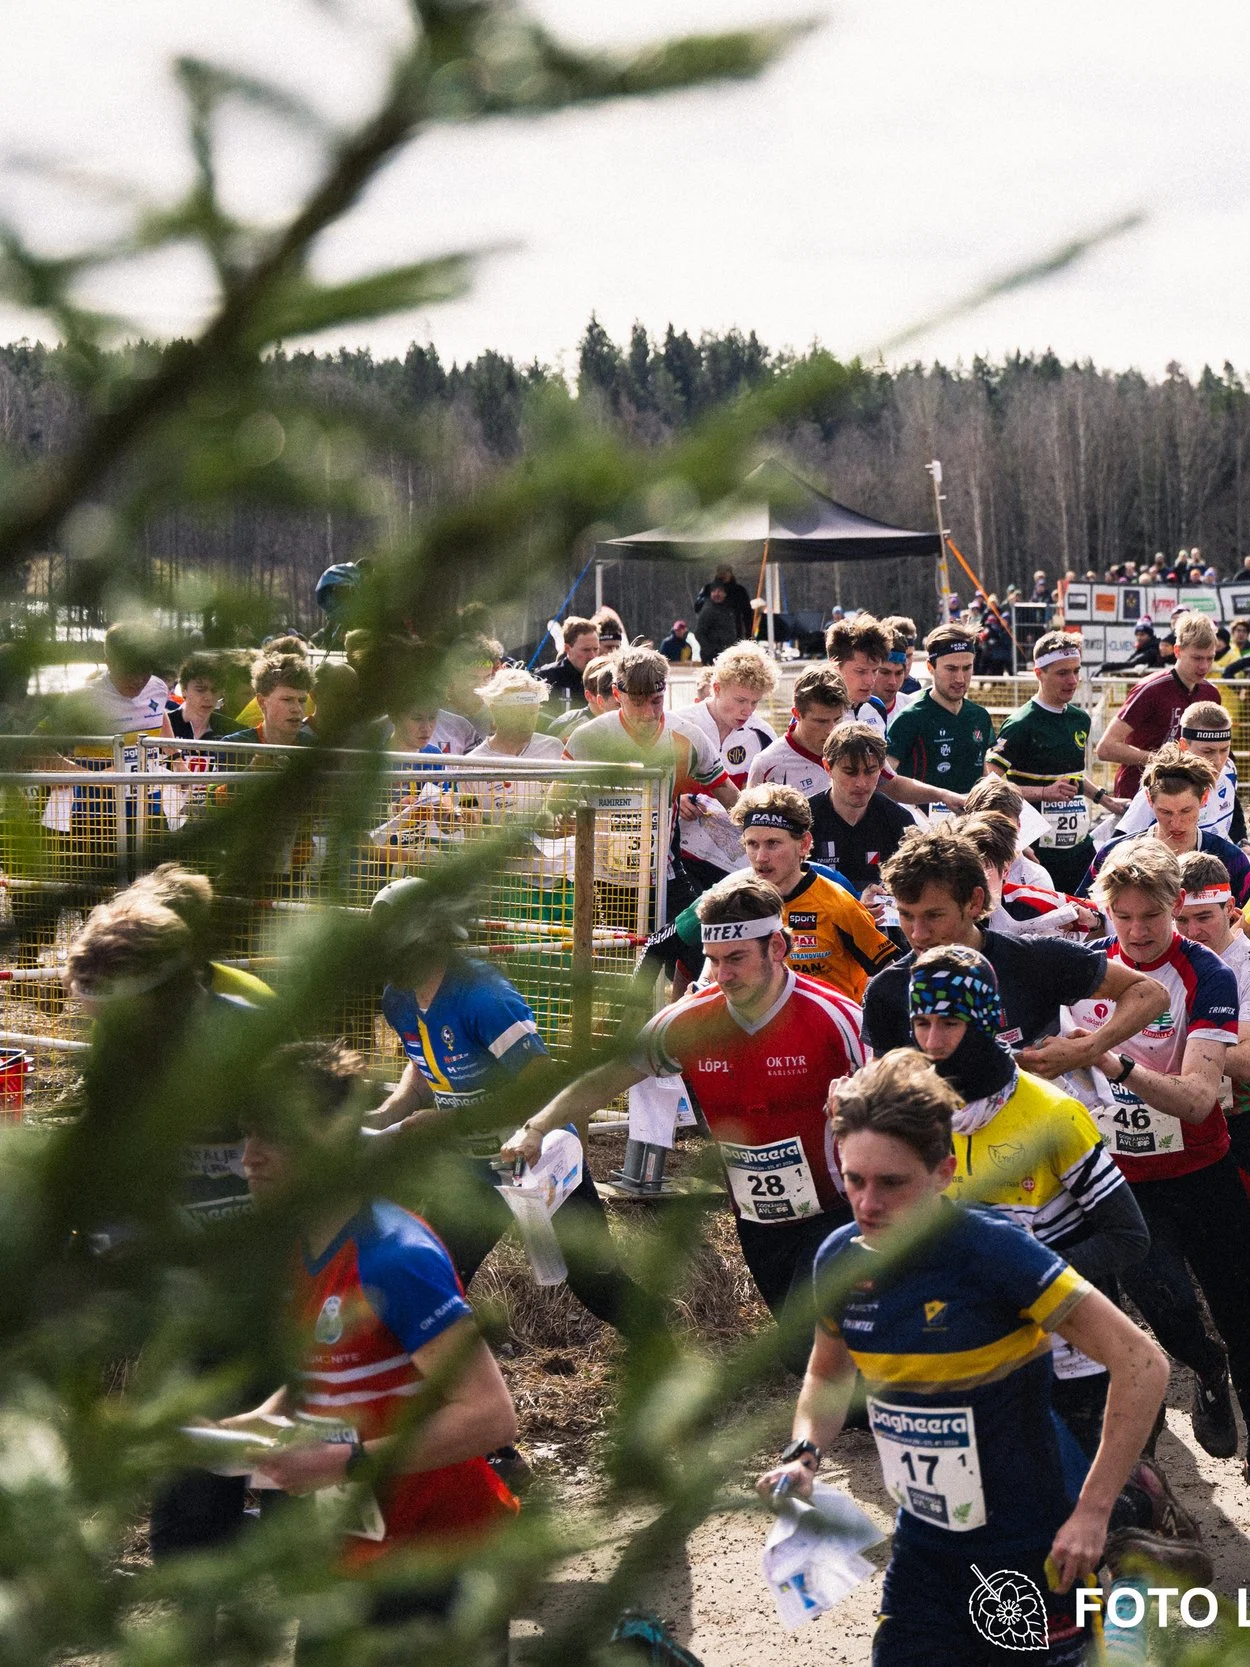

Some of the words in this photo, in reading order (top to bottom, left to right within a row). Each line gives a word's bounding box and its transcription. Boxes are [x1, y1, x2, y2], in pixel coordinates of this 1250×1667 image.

[799, 778, 813, 787] TB
[597, 798, 632, 807] RAMIRENT
[751, 813, 788, 823] PAN-
[1056, 816, 1078, 830] 20
[789, 914, 816, 924] sport
[703, 924, 744, 941] MTEX
[1208, 1006, 1236, 1016] TRIMTEX
[766, 1056, 783, 1068] OK
[785, 1055, 806, 1067] TYR
[767, 1067, 808, 1077] KARLSTAD
[1113, 1107, 1151, 1129] 46
[721, 1144, 799, 1163] bagheera
[795, 1168, 802, 1177] 1
[747, 1174, 786, 1197] 28
[871, 1409, 967, 1435] bagheera
[957, 1453, 967, 1468] 1
[900, 1451, 940, 1486] 17
